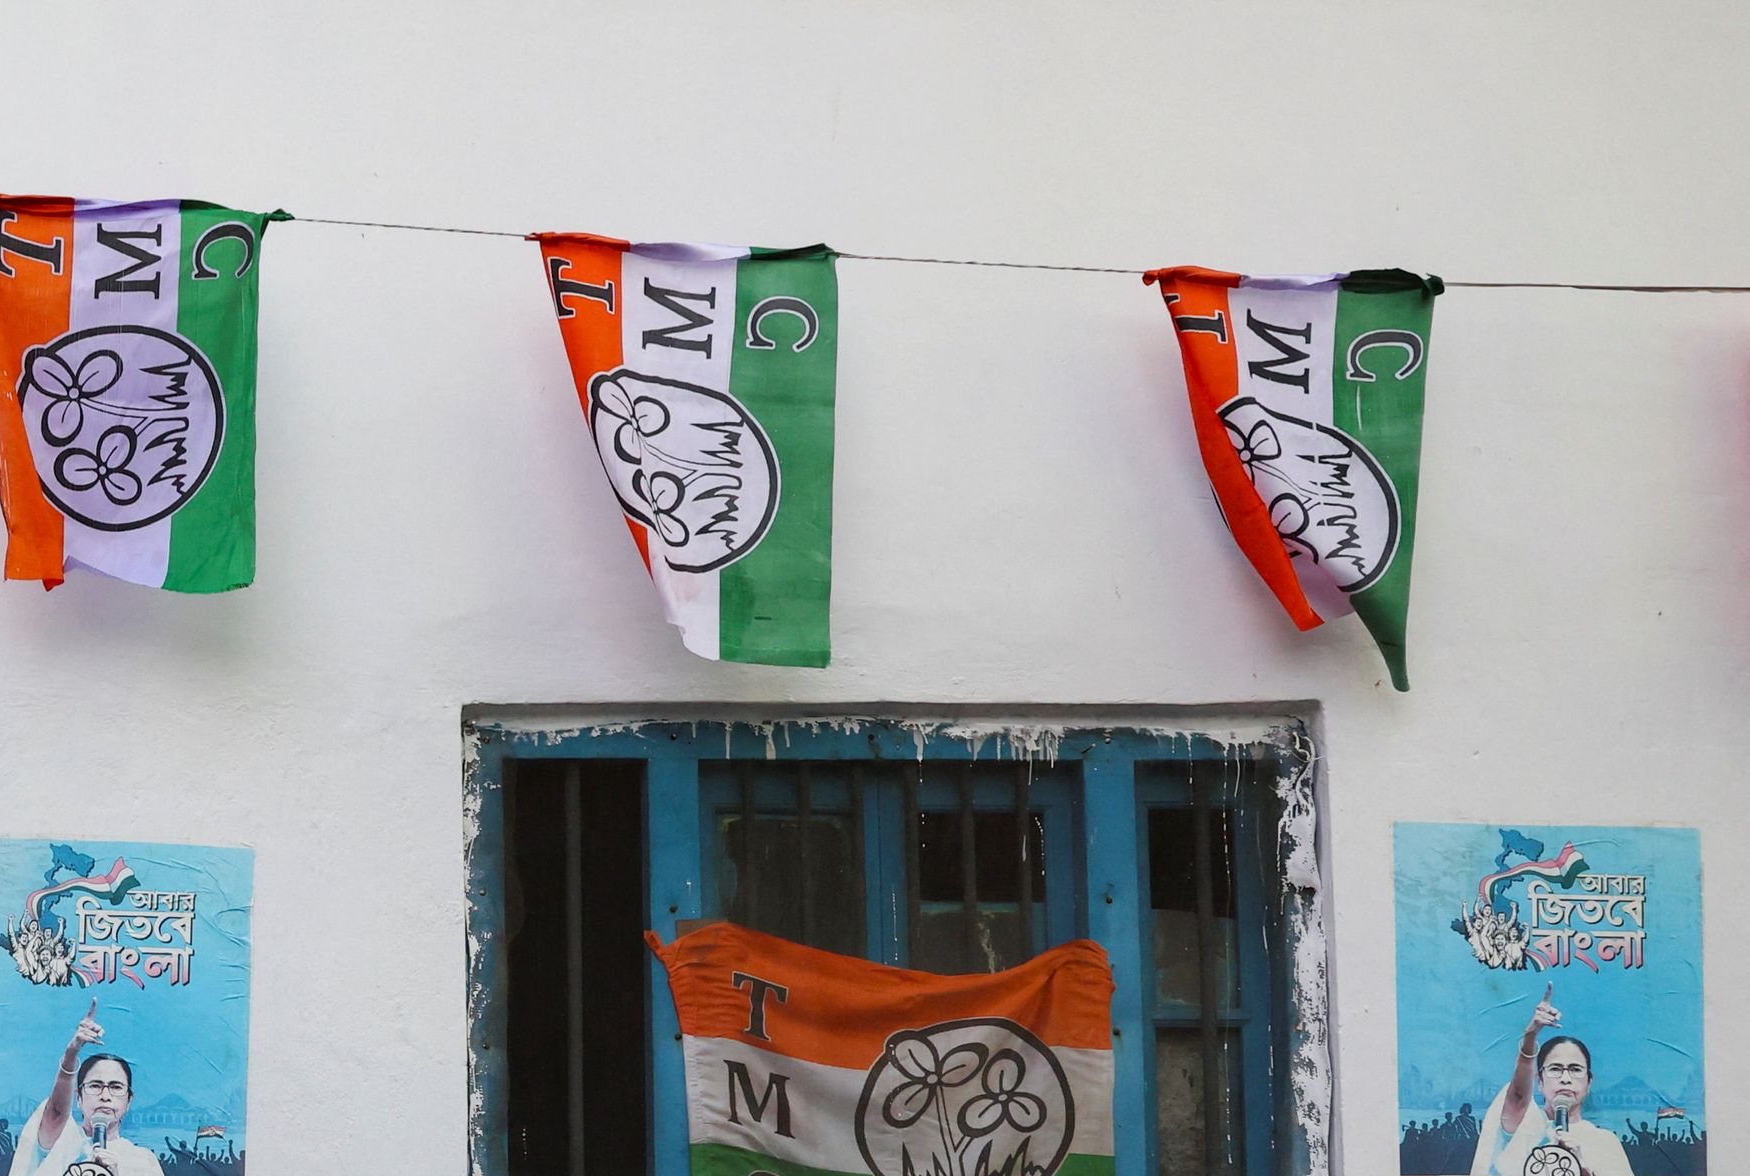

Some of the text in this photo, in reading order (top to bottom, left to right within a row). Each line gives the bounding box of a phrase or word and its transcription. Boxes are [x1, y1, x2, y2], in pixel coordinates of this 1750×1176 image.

[126, 890, 196, 912] আবার
[1527, 880, 1645, 928] জিতবে
[1576, 873, 1646, 895] আবার
[75, 896, 195, 944] জিতবে
[78, 944, 194, 990] বাংলা
[1531, 928, 1646, 974] বাংলা
